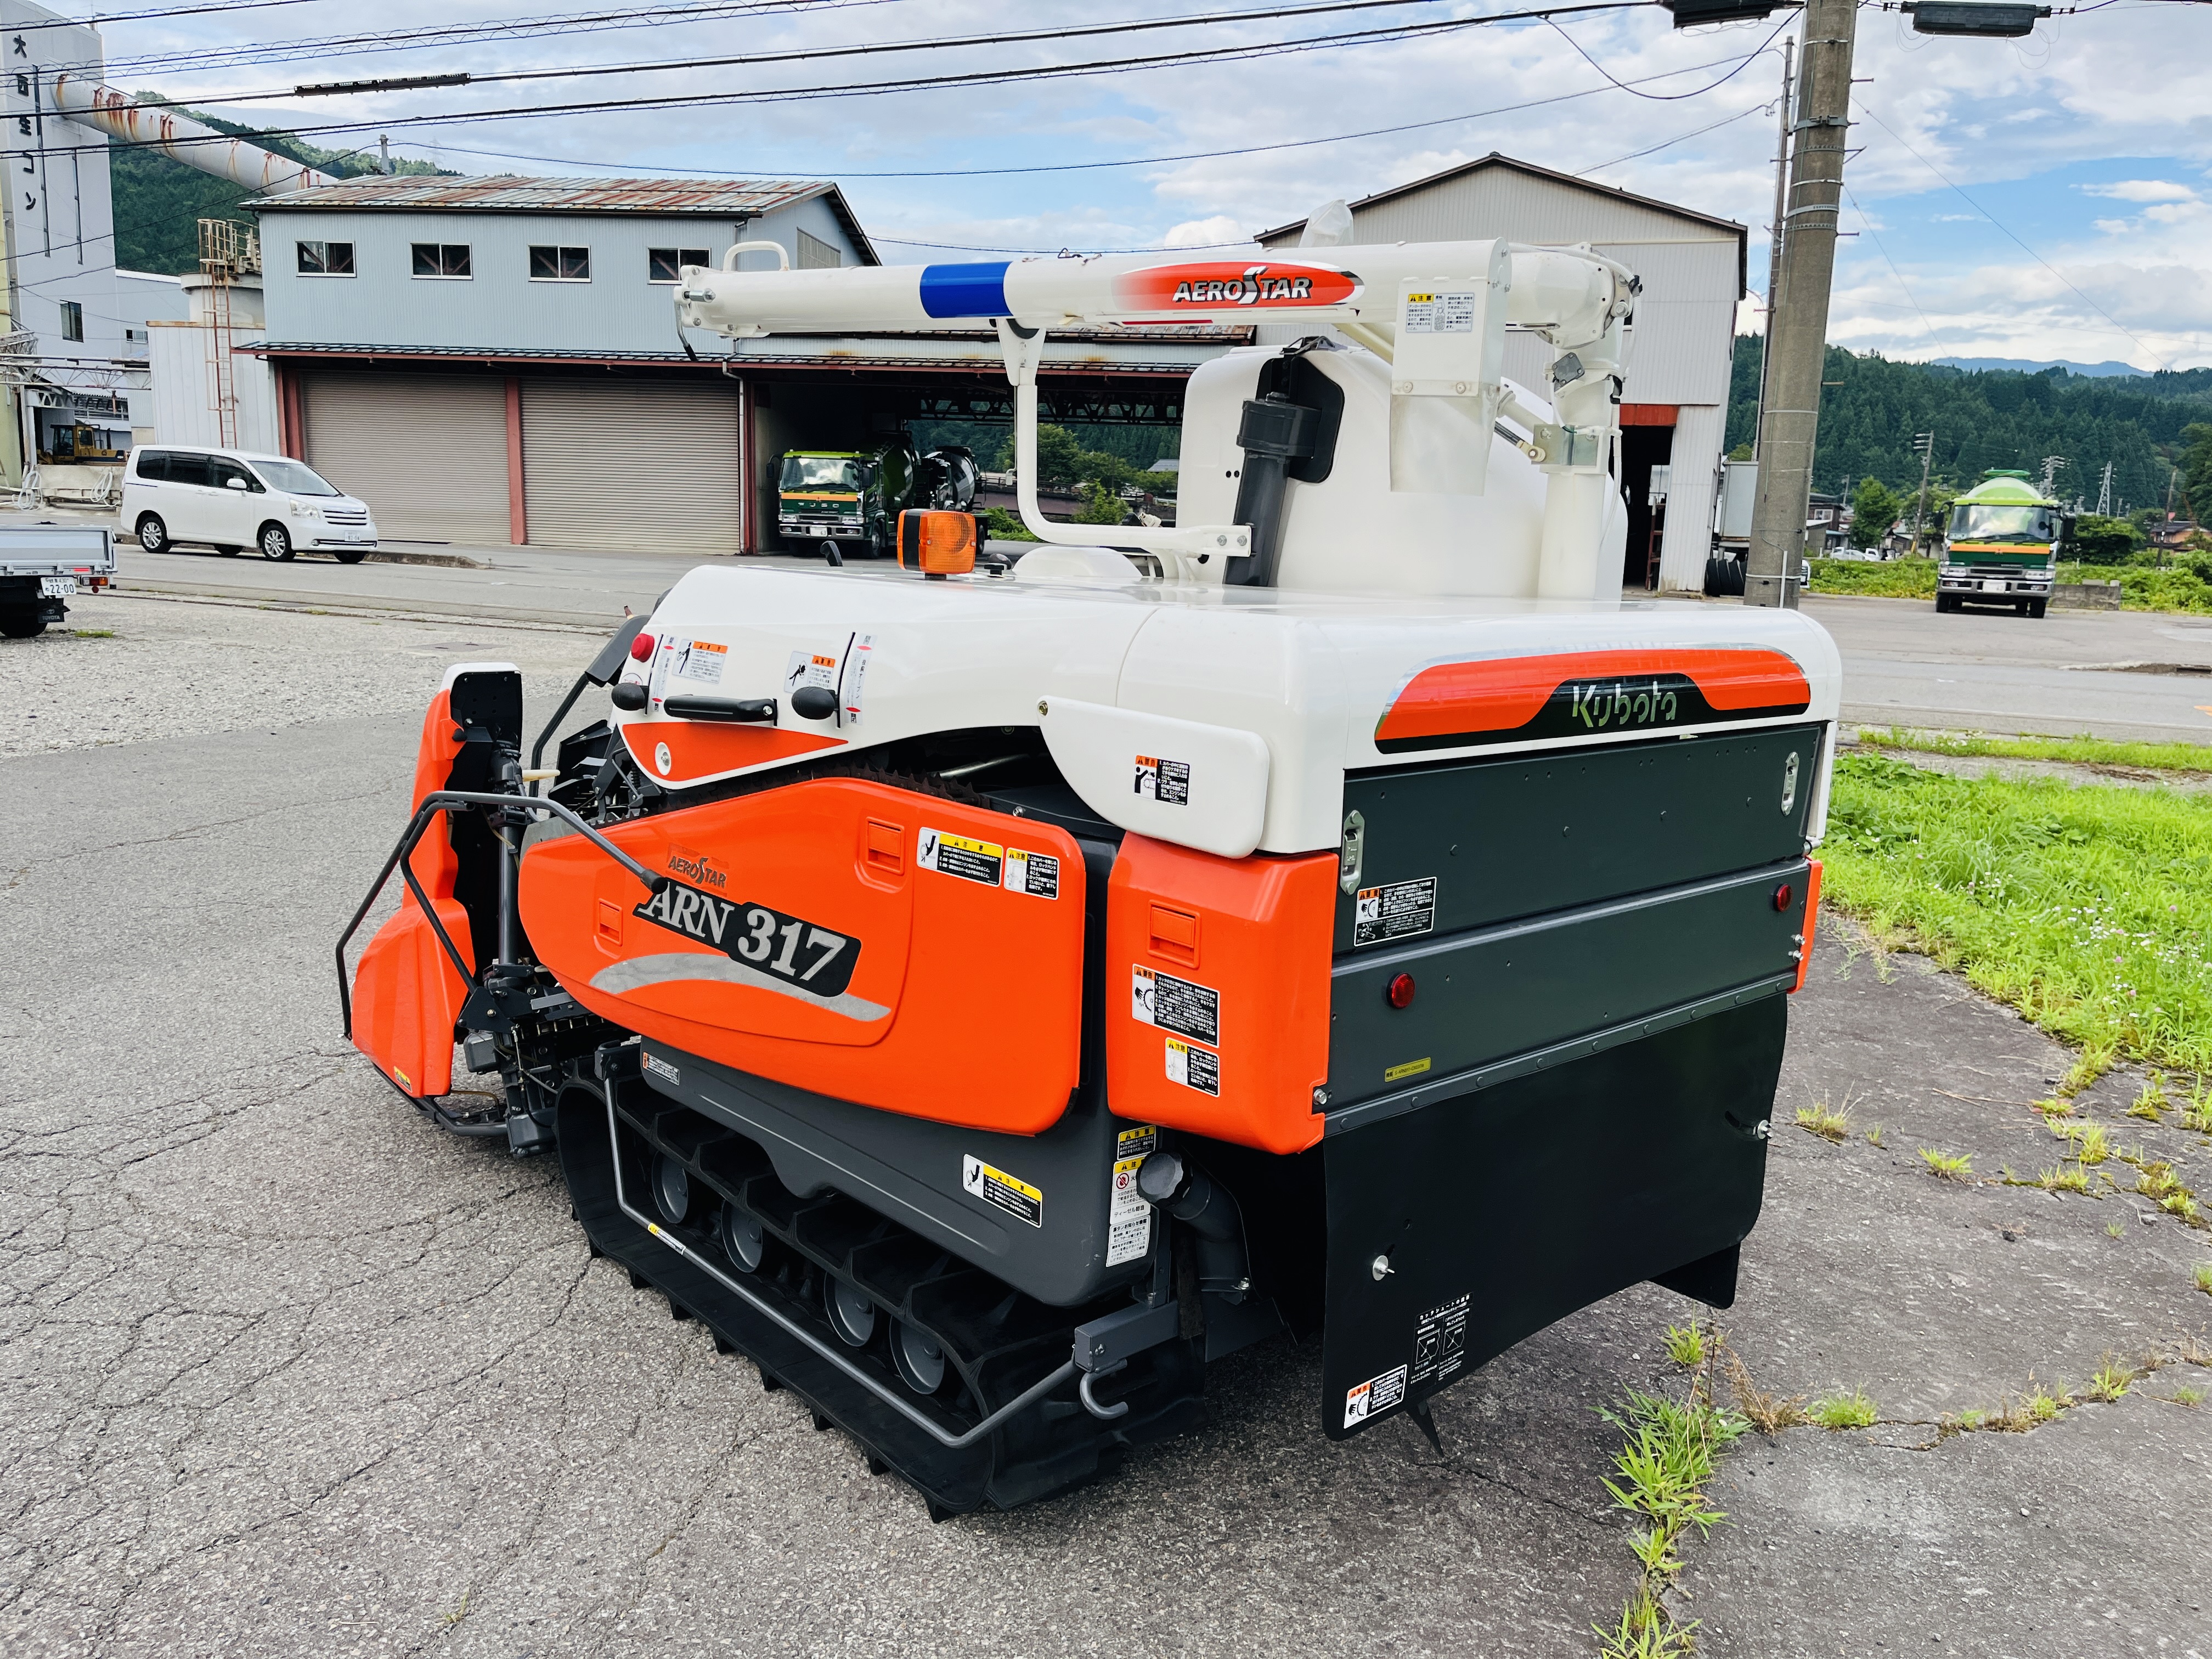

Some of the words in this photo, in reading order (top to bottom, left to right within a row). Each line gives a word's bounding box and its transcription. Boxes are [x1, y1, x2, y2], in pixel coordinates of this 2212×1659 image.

[1172, 266, 1313, 305] AEROSTAR
[50, 584, 74, 594] 22-00
[1572, 681, 1677, 727] Kubota
[1016, 851, 1025, 860] 注意
[668, 856, 726, 889] AEROSTAR
[637, 881, 735, 945] ARN
[737, 909, 848, 982] 317
[1176, 1043, 1186, 1052] 注意
[1135, 1128, 1150, 1137] 注意
